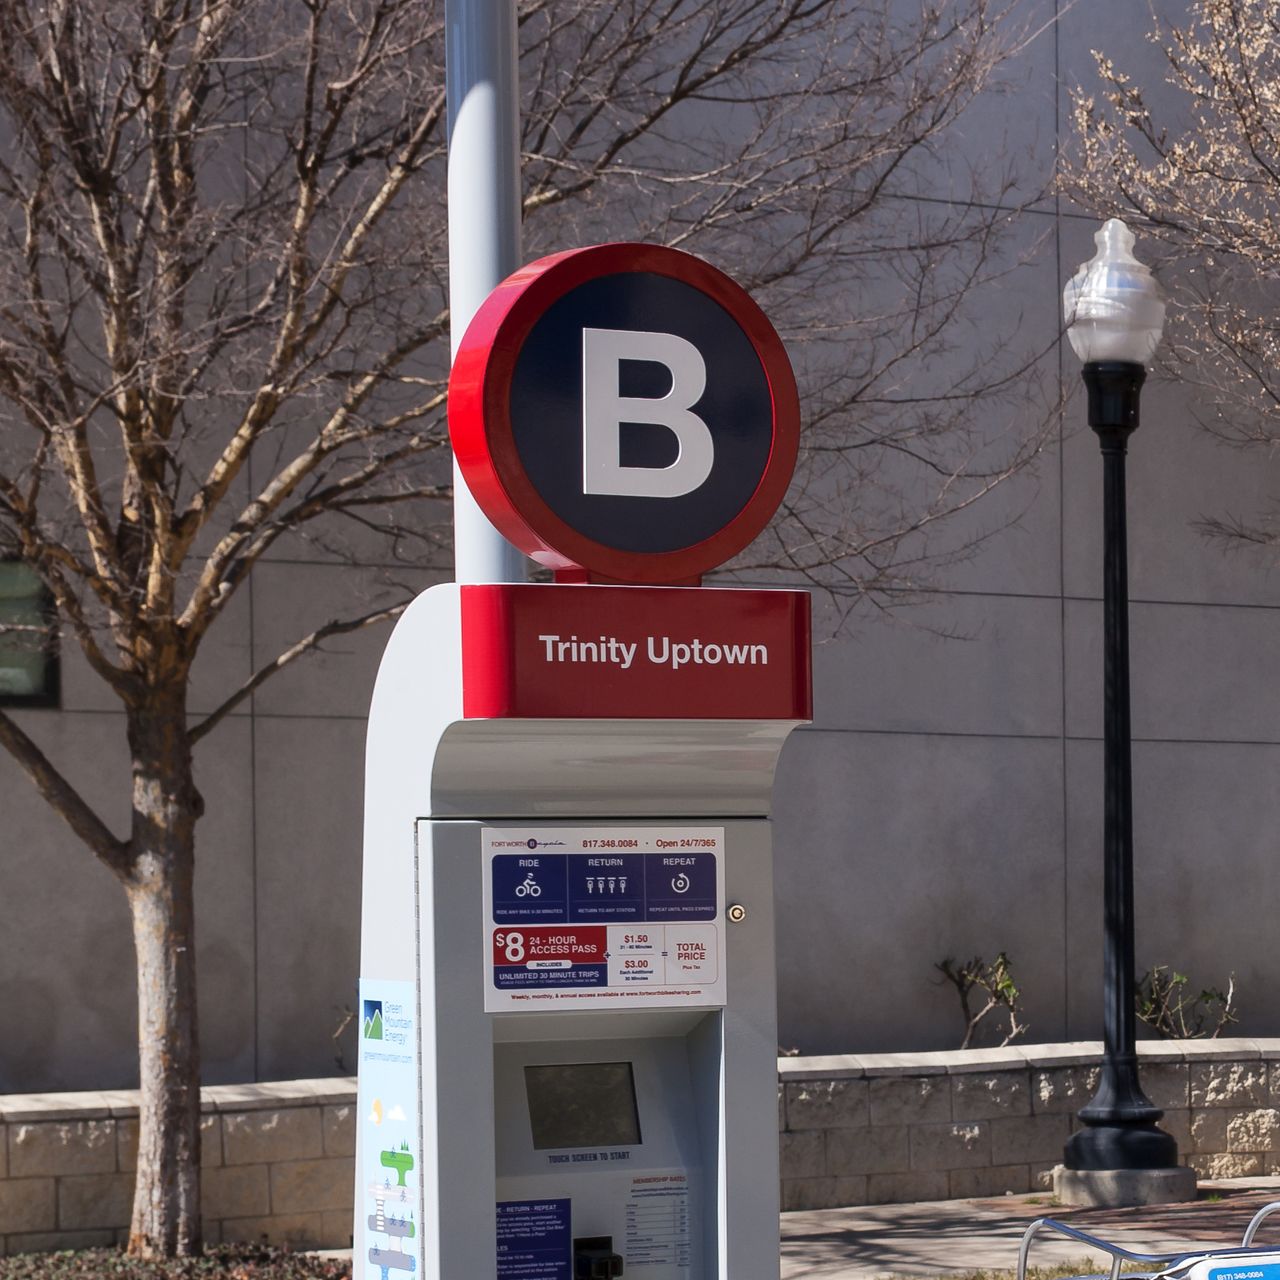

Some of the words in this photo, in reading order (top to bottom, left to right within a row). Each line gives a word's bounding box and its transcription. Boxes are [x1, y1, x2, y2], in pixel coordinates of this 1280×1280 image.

[583, 327, 714, 498] B
[539, 635, 638, 669] Trinity
[648, 636, 768, 670] Uptown
[582, 839, 638, 848] 817.348.0084
[656, 839, 678, 849] Open
[680, 839, 716, 848] 24/7/365
[519, 859, 539, 867] RIDE
[588, 858, 623, 866] RETURN
[663, 857, 696, 866] REPEAT
[529, 936, 540, 945] 24
[549, 935, 576, 944] HOUR
[624, 934, 648, 943] $1.50
[496, 932, 525, 962] $8
[530, 945, 569, 954] ACCESS
[572, 944, 597, 953] PASS
[676, 943, 706, 952] TOTAL
[677, 952, 705, 961] PRICE
[624, 959, 648, 969] $3.00
[499, 972, 538, 980] UNLIMITED
[550, 971, 577, 979] MINUTE
[385, 1000, 402, 1014] Green
[385, 1016, 411, 1029] Mountain
[548, 1154, 570, 1164] TOUCH
[599, 1152, 609, 1161] TO
[610, 1151, 630, 1161] START
